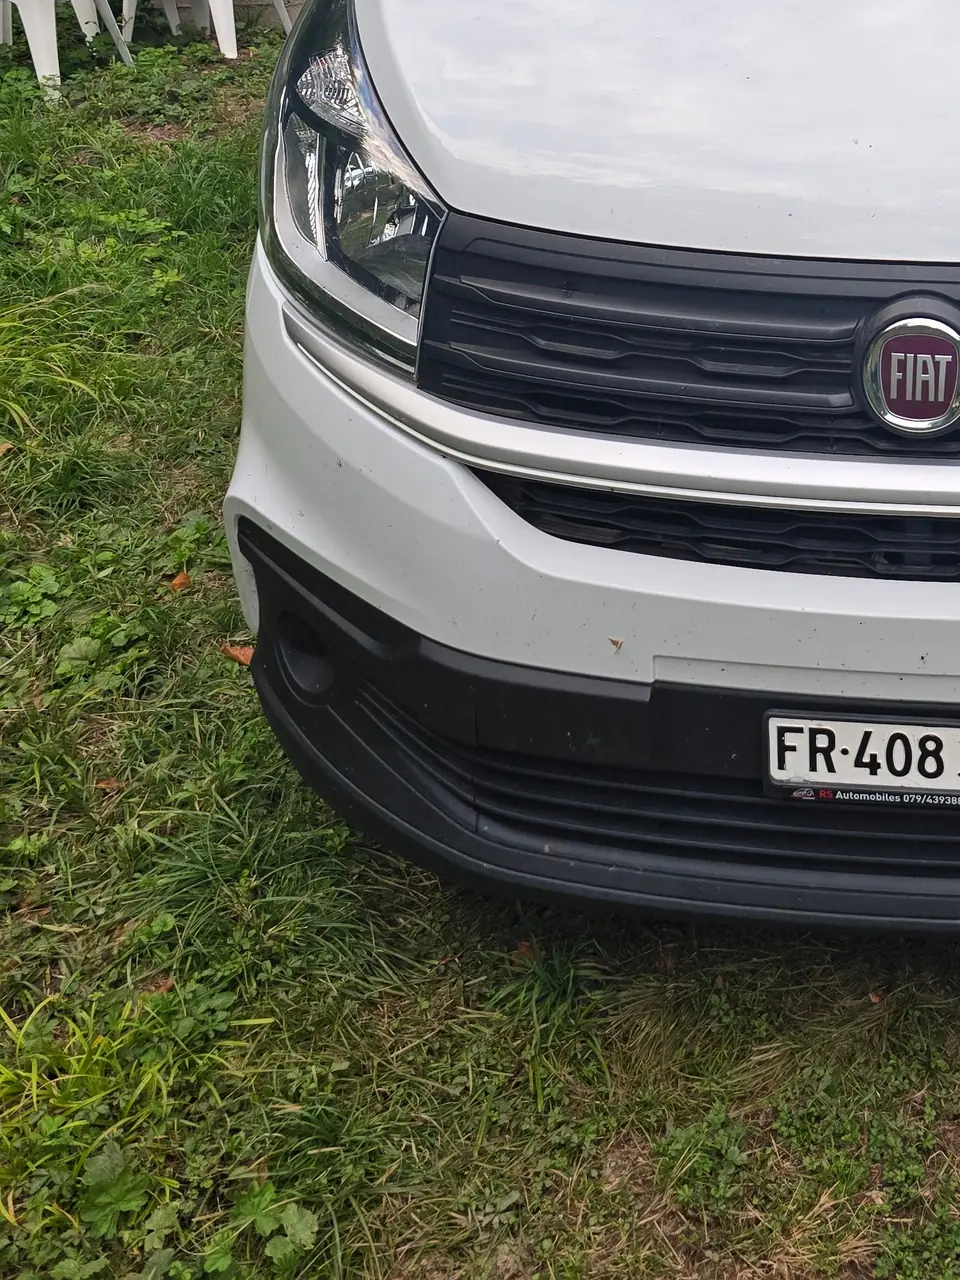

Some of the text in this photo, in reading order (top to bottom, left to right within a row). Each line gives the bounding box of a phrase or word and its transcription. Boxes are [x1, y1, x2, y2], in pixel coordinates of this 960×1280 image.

[890, 352, 952, 402] FIAT
[819, 790, 833, 798] RS
[835, 790, 901, 802] Automobiles
